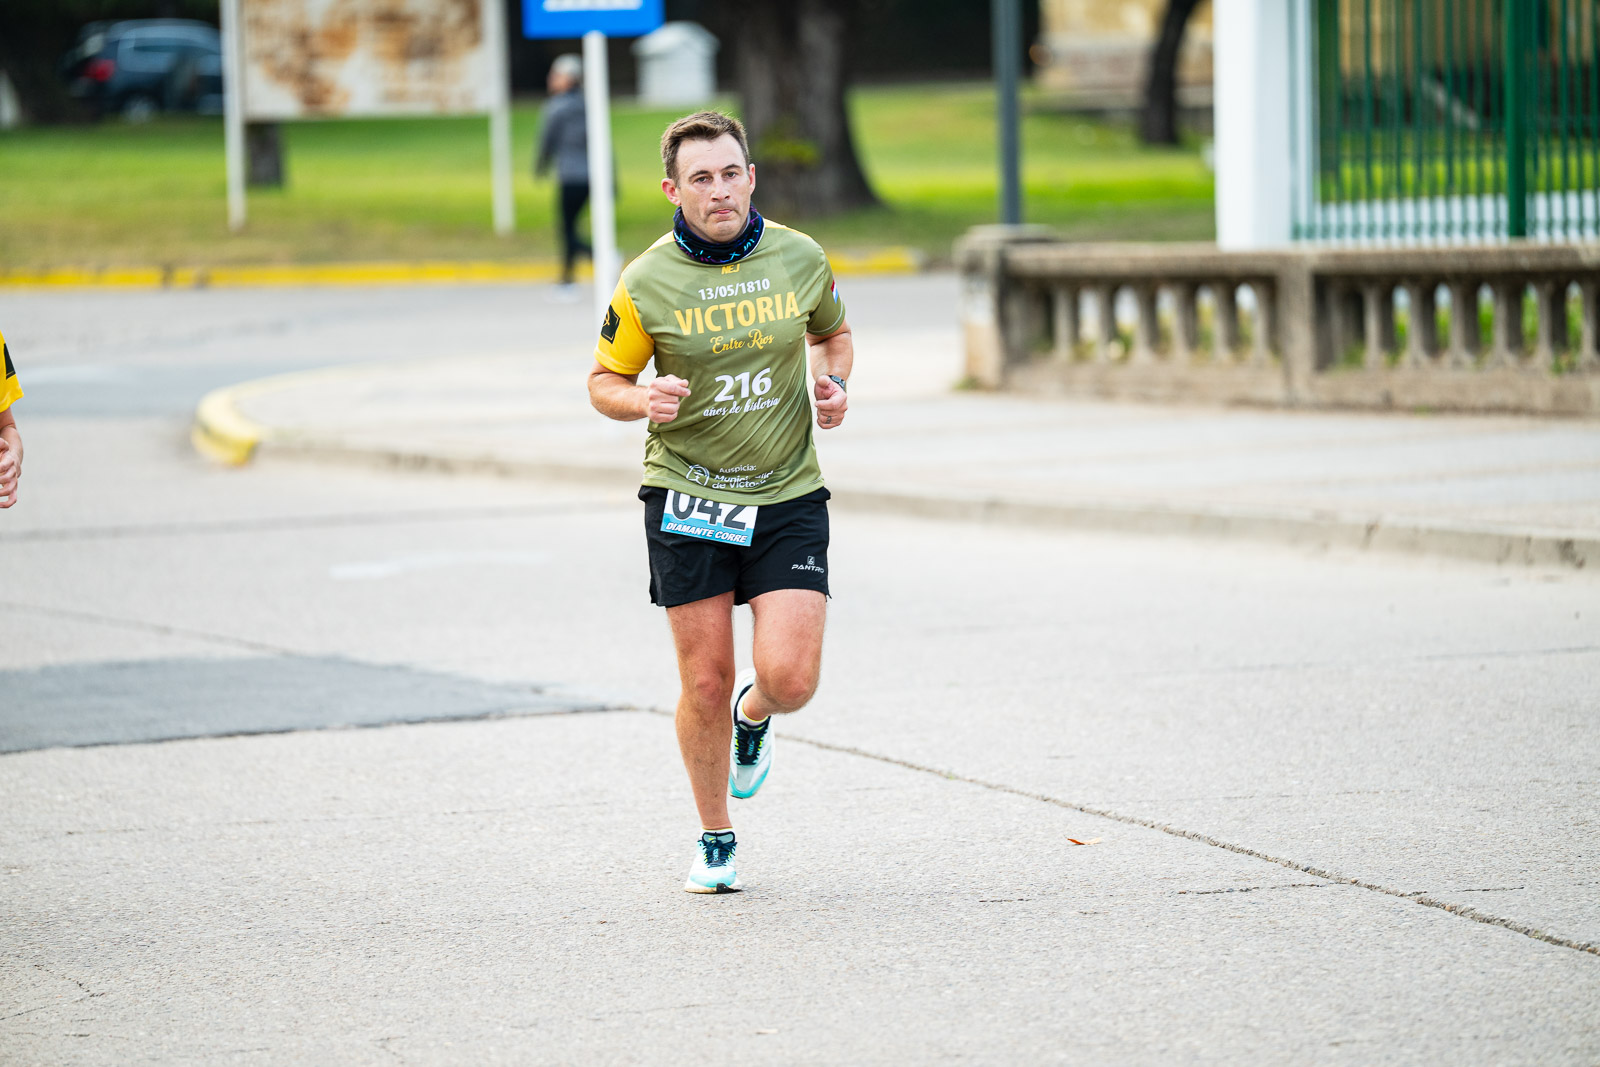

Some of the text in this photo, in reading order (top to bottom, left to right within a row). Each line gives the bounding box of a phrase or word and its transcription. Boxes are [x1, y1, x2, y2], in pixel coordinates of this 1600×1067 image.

[698, 278, 770, 301] 13/05/1810
[674, 291, 801, 336] VICTORIA
[710, 336, 745, 354] Entre
[714, 367, 772, 402] 216
[729, 402, 741, 414] de
[743, 396, 781, 413] historia
[665, 522, 748, 543] DIAMANTE CORRE
[791, 563, 825, 574] PANTRO
